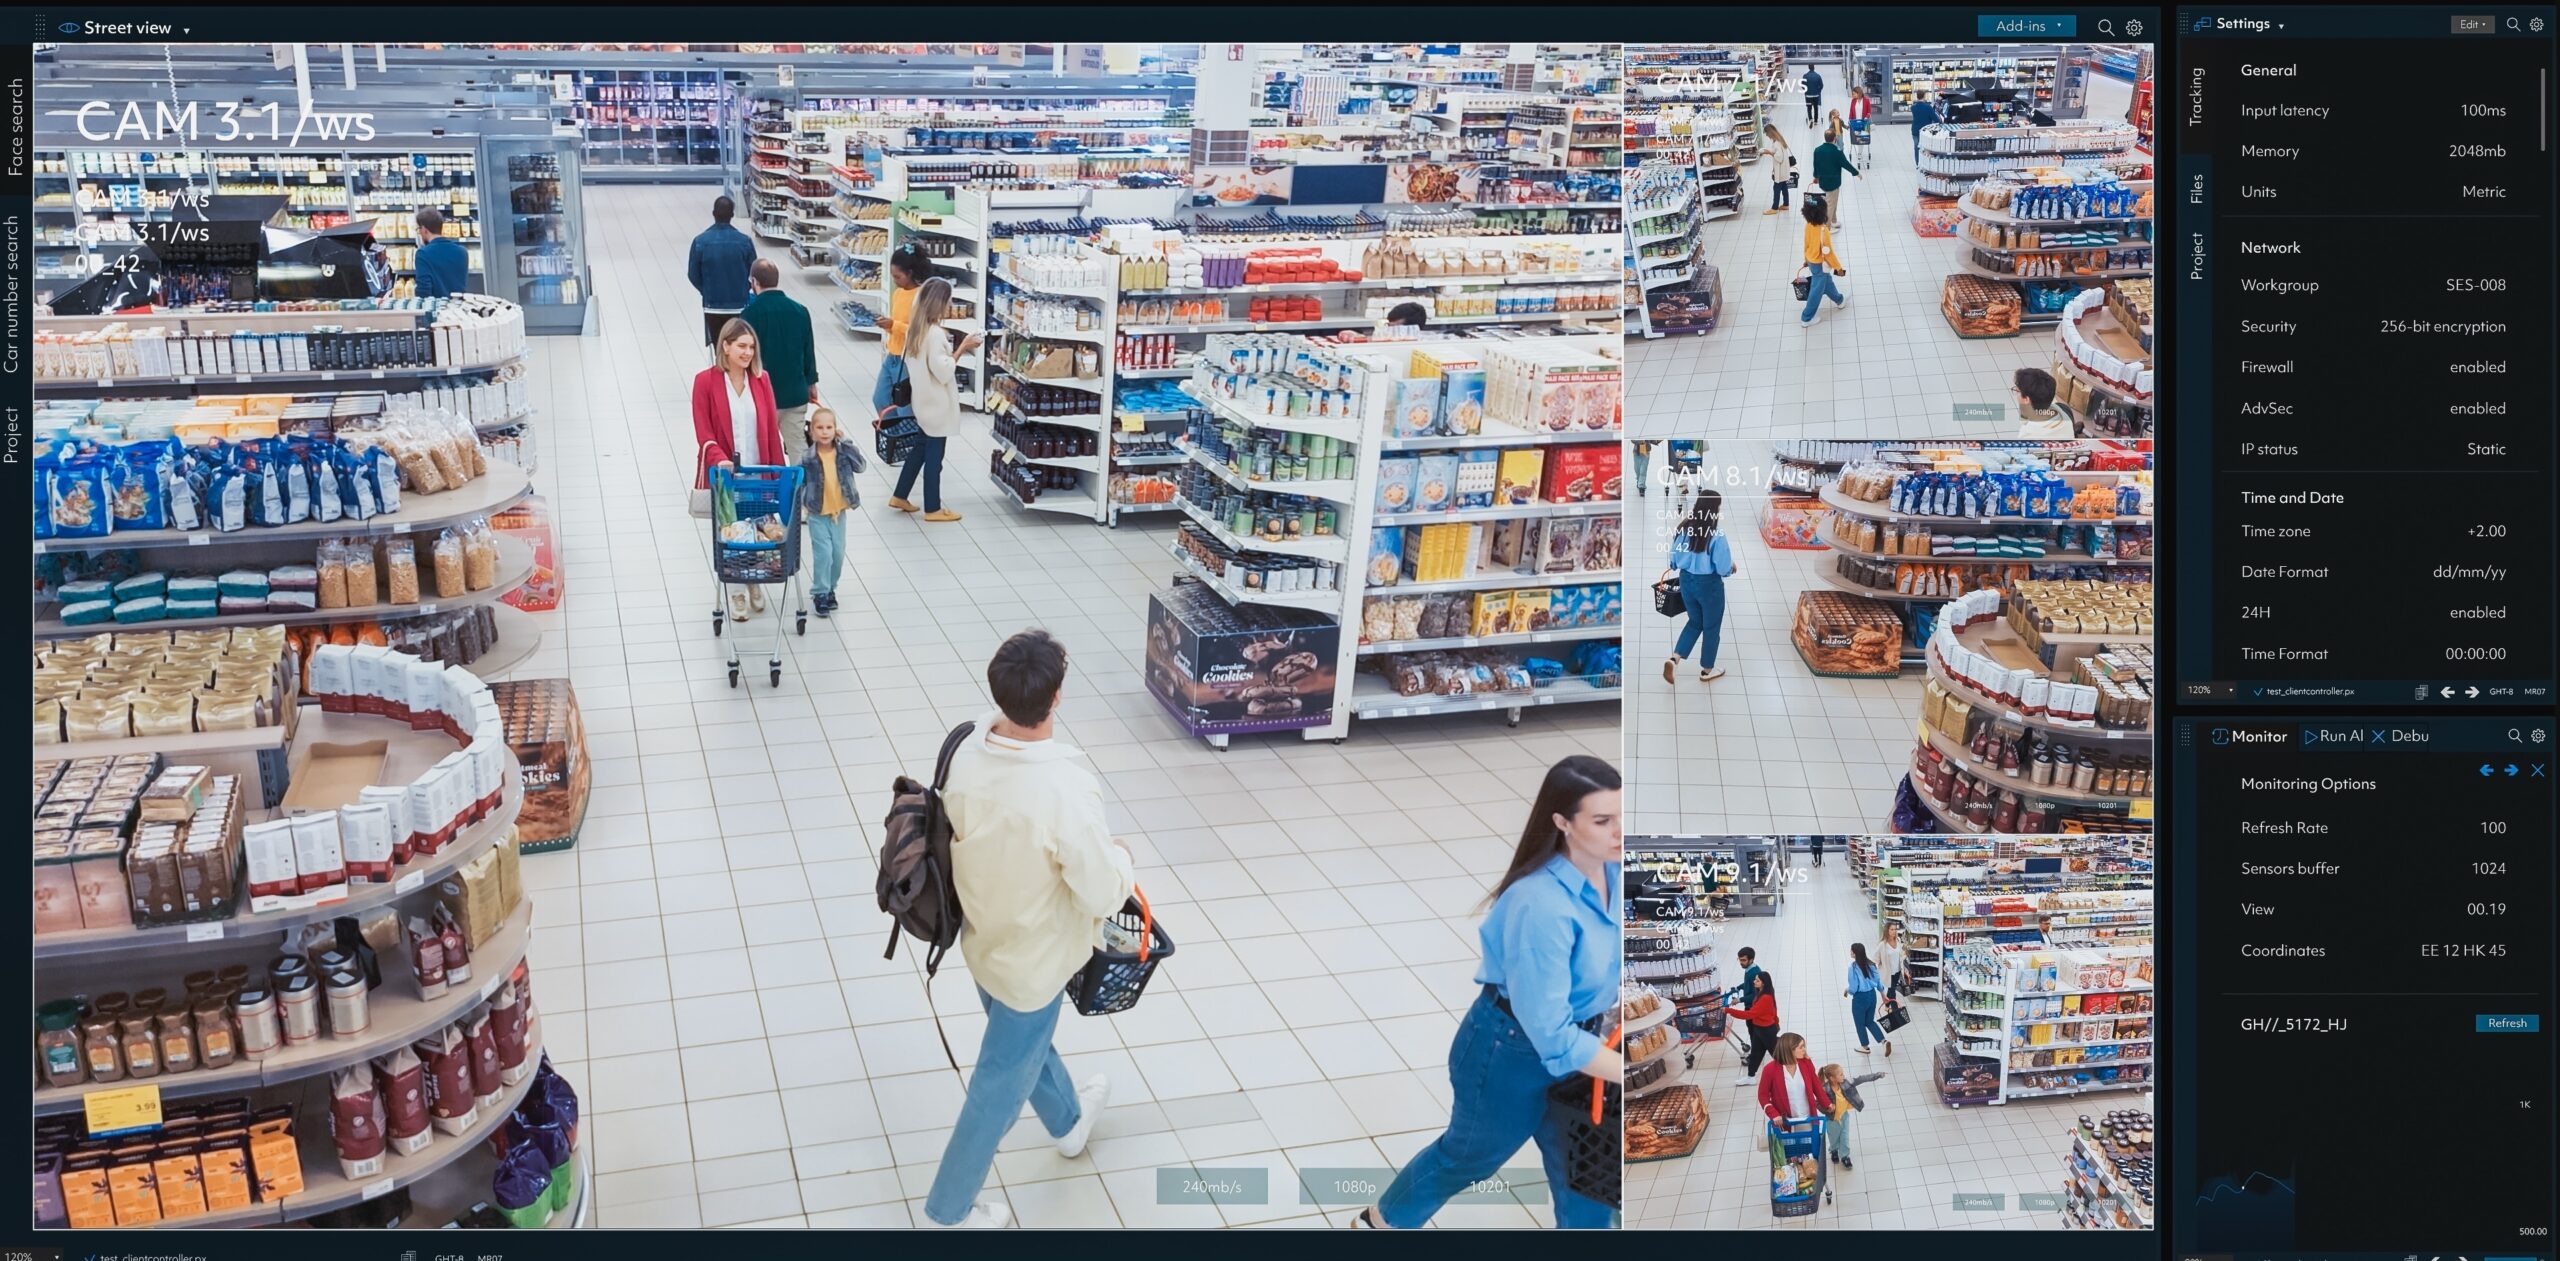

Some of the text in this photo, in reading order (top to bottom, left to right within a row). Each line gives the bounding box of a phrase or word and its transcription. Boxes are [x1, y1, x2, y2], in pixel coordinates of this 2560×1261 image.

[84, 20, 172, 35] Street view
[1996, 20, 2046, 32] Add-ins
[2216, 17, 2271, 32] Settings
[2460, 19, 2479, 30] Edit
[2240, 63, 2297, 77] General
[1657, 71, 1808, 97] CAM 7.1/ws
[2188, 67, 2206, 127] Tracking
[2242, 103, 2330, 120] Input latency
[2461, 103, 2507, 117] 100ms
[7, 78, 24, 176] Face search
[76, 98, 376, 147] CAM 3.1/ws
[1656, 135, 1683, 144] CAM
[2242, 144, 2300, 160] Memory
[2449, 144, 2507, 158] 2048mb
[2190, 174, 2204, 204] Files
[2241, 185, 2277, 198] Units
[2463, 185, 2507, 198] Metric
[76, 187, 210, 209] CAM 3.1/ws
[76, 222, 210, 244] CAM 3.1/ws
[2241, 240, 2301, 254] Network
[2190, 232, 2207, 280] Project
[2240, 278, 2320, 295] Workgroup
[2446, 278, 2506, 293] SES-008
[3, 215, 19, 373] Car number search
[2241, 319, 2297, 336] Security
[2381, 319, 2506, 337] 256-bit encryption
[2241, 360, 2294, 373] Firewall
[2450, 360, 2506, 374] enabled
[2241, 401, 2294, 415] AdvSec
[2450, 401, 2506, 415] enabled
[3, 406, 22, 463] Project
[2241, 442, 2298, 456] IP status
[2467, 442, 2507, 456] Static
[1657, 464, 1809, 490] CAM 8.1/ws
[2241, 490, 2345, 504] Time and Date
[1656, 509, 1725, 521] CAM 8.1/ws
[1656, 526, 1725, 538] CAM 8.1/ws
[2241, 524, 2311, 538] Time zone
[2468, 524, 2507, 538] +2.00
[2242, 565, 2329, 578] Date Format
[2433, 564, 2507, 581] dd/mm/yy
[2241, 606, 2271, 619] 24H
[2450, 605, 2506, 619] enabled
[2241, 647, 2329, 660] Time Format
[2445, 647, 2507, 660] 00:00:00
[1202, 669, 1254, 684] Cookies
[2188, 685, 2211, 695] 120%
[2266, 686, 2355, 699] test_clientcontroller.px
[2489, 687, 2514, 696] GHT-8
[2524, 687, 2546, 696] MR07
[2232, 730, 2288, 743] Monitor
[2320, 729, 2347, 742] Run
[2392, 728, 2429, 742] Debu
[520, 762, 548, 772] tmeal
[521, 770, 561, 785] okies
[2241, 777, 2377, 794] Monitoring Options
[1964, 802, 1993, 810] 240mb/s
[2035, 802, 2055, 810] 1080p
[2241, 820, 2329, 834] Refresh Rate
[2480, 821, 2507, 834] 100
[1657, 861, 1809, 887] CAM 9.1/ws
[2241, 861, 2340, 875] Sensors buffer
[2472, 862, 2507, 875] 1024
[1656, 906, 1725, 918] CAM 9.1/ws
[2241, 903, 2275, 916] View
[2467, 902, 2507, 916] 00.19
[2241, 943, 2326, 957] Coordinates
[2421, 944, 2506, 957] EE 12 HK 45
[2241, 1017, 2347, 1034] GH//_5172_HJ
[2488, 1017, 2528, 1028] Refresh
[136, 1102, 157, 1113] 3.99
[2519, 1100, 2532, 1109] 1K
[1656, 1127, 1683, 1135] Cookies
[1183, 1179, 1242, 1195] 240mb/s
[1334, 1180, 1377, 1196] 1080p
[1470, 1181, 1511, 1193] 10201
[2519, 1227, 2548, 1236] 500.00
[4, 1252, 33, 1261] 120%
